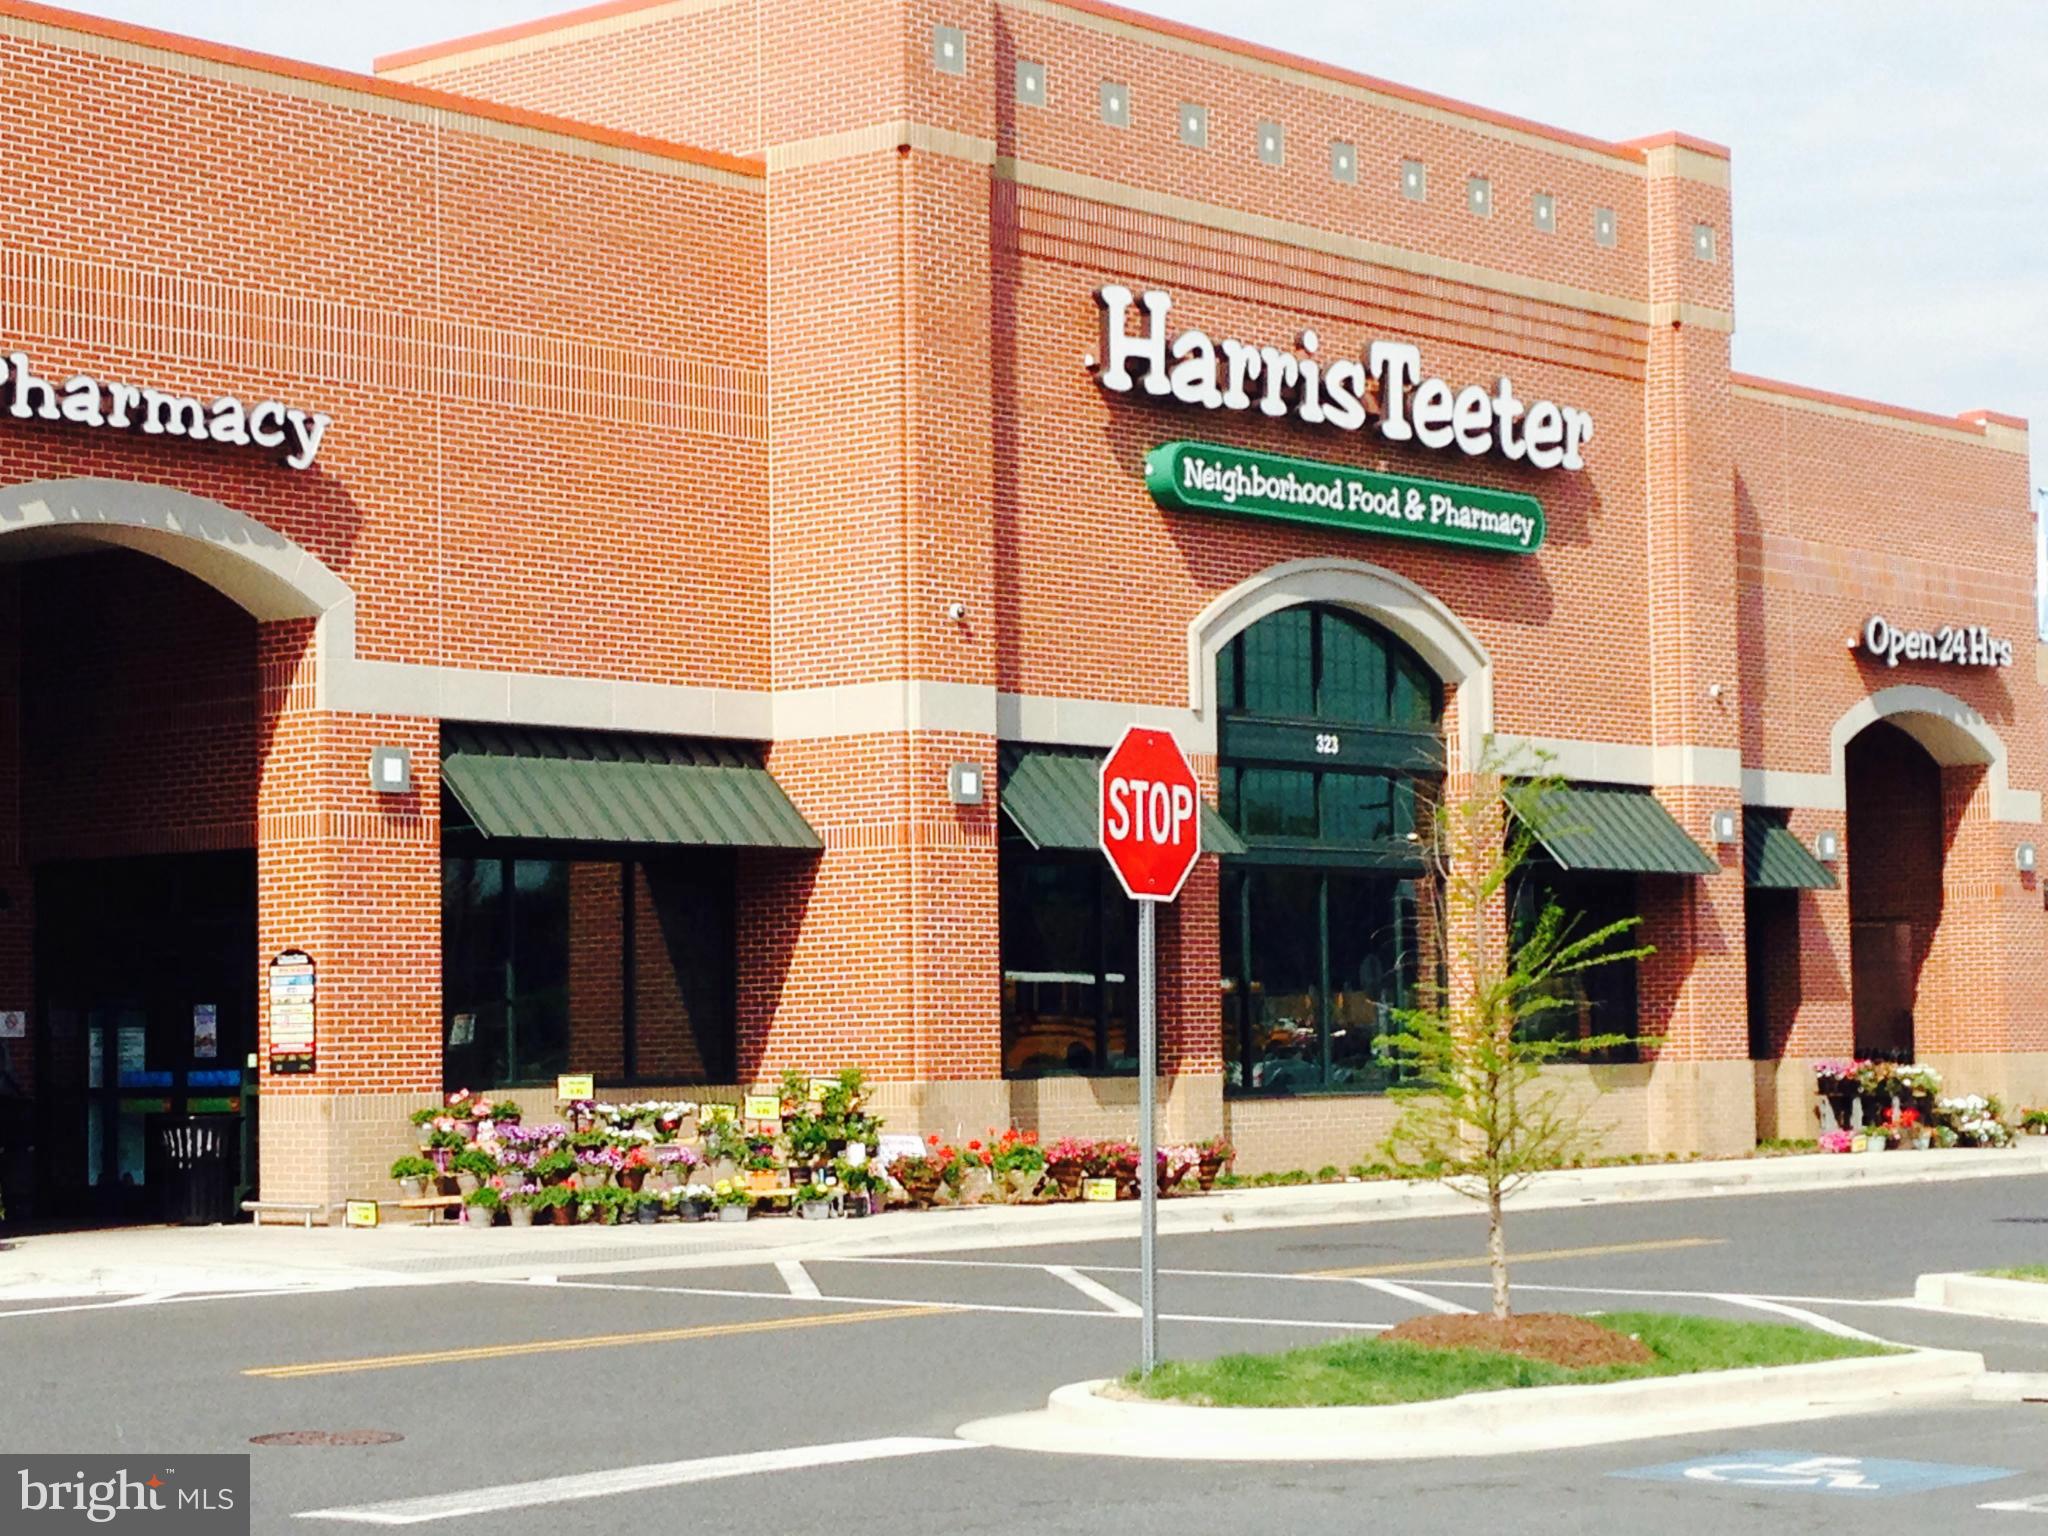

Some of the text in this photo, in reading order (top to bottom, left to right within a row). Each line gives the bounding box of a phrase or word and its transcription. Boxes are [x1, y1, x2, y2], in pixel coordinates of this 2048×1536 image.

[0, 351, 333, 470] harmacy
[1100, 284, 1593, 471] Harris Teeter
[1183, 456, 1535, 546] Neighborhood Food & Pharmacy
[1866, 614, 2013, 667] Open 24 Hrs
[1315, 733, 1339, 755] 323
[1108, 776, 1193, 845] STOP
